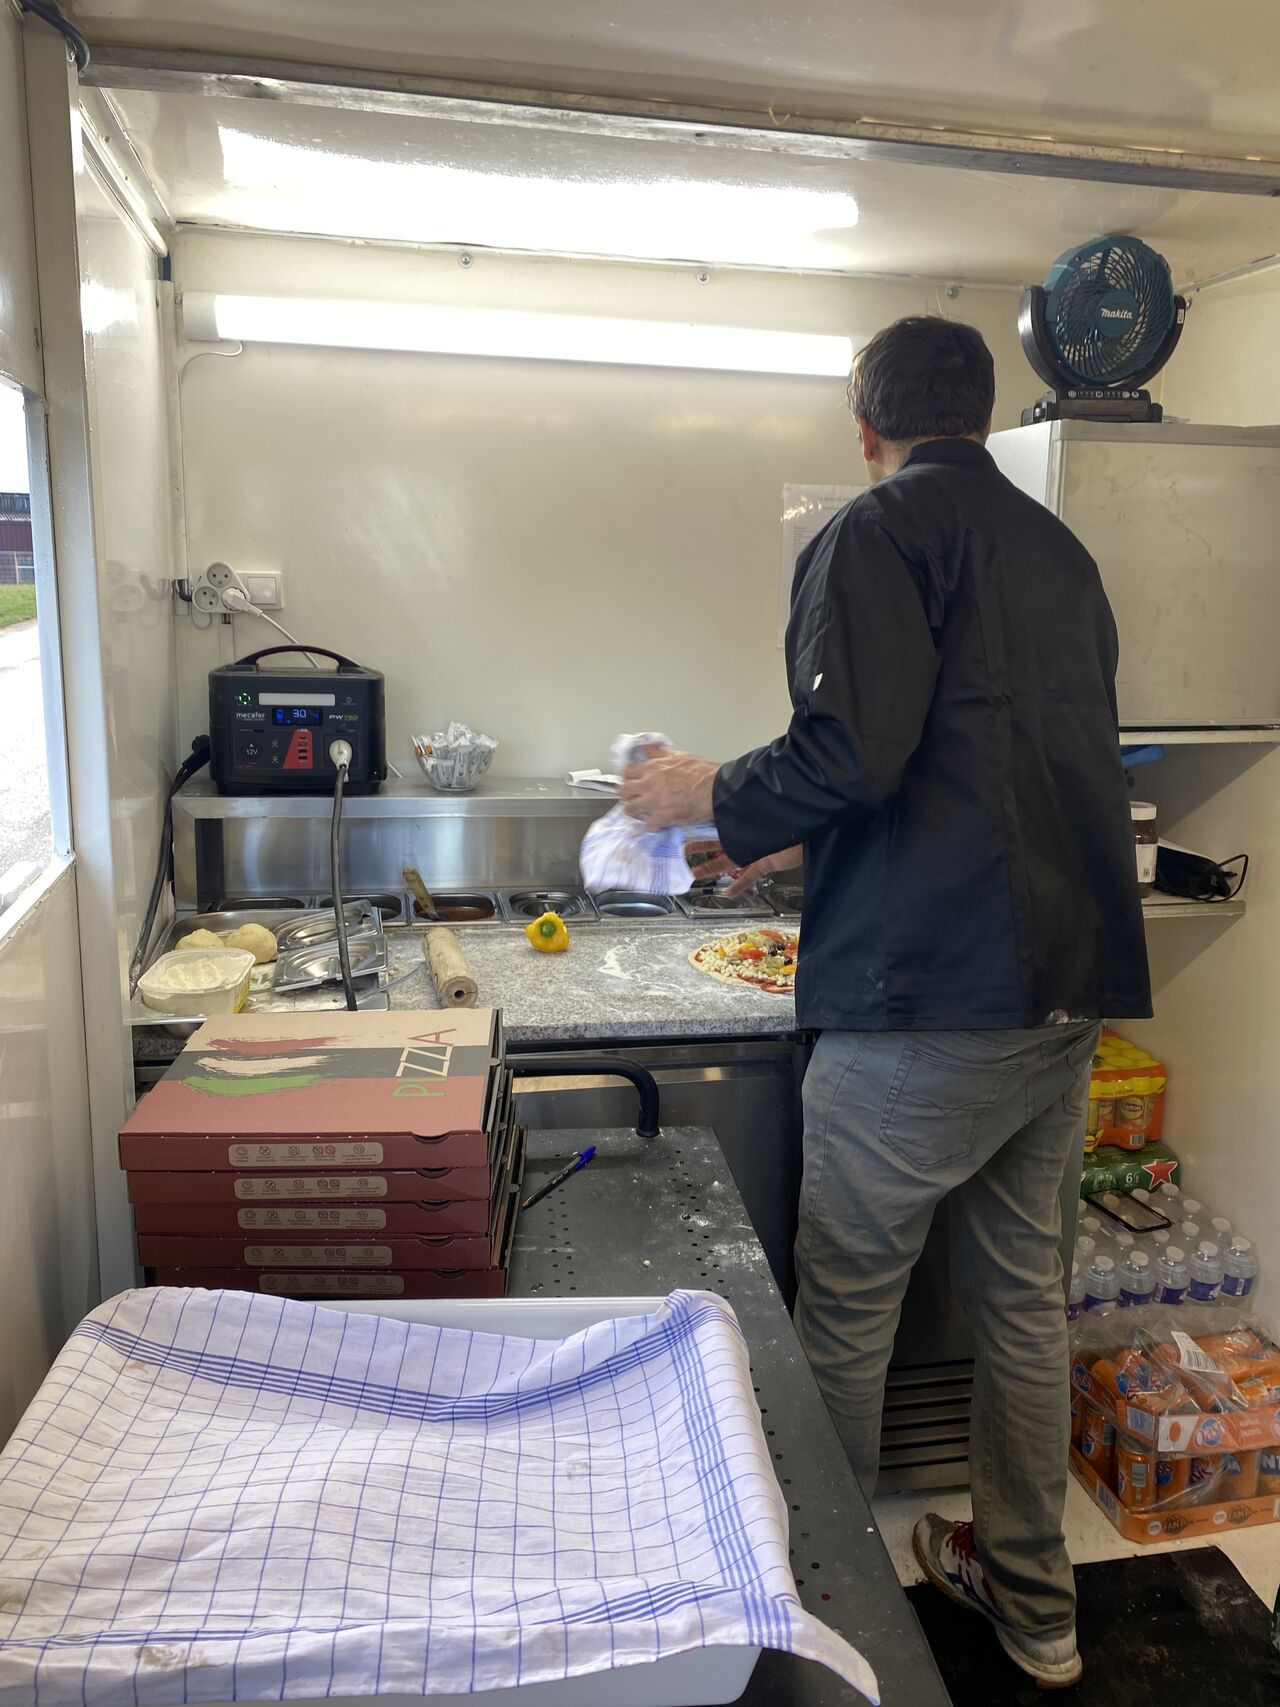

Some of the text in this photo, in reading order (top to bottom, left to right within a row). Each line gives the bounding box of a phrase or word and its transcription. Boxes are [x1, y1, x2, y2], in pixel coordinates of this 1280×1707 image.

[236, 711, 265, 719] mecafer
[391, 1028, 457, 1098] PIZZA
[1125, 1172, 1133, 1185] 6
